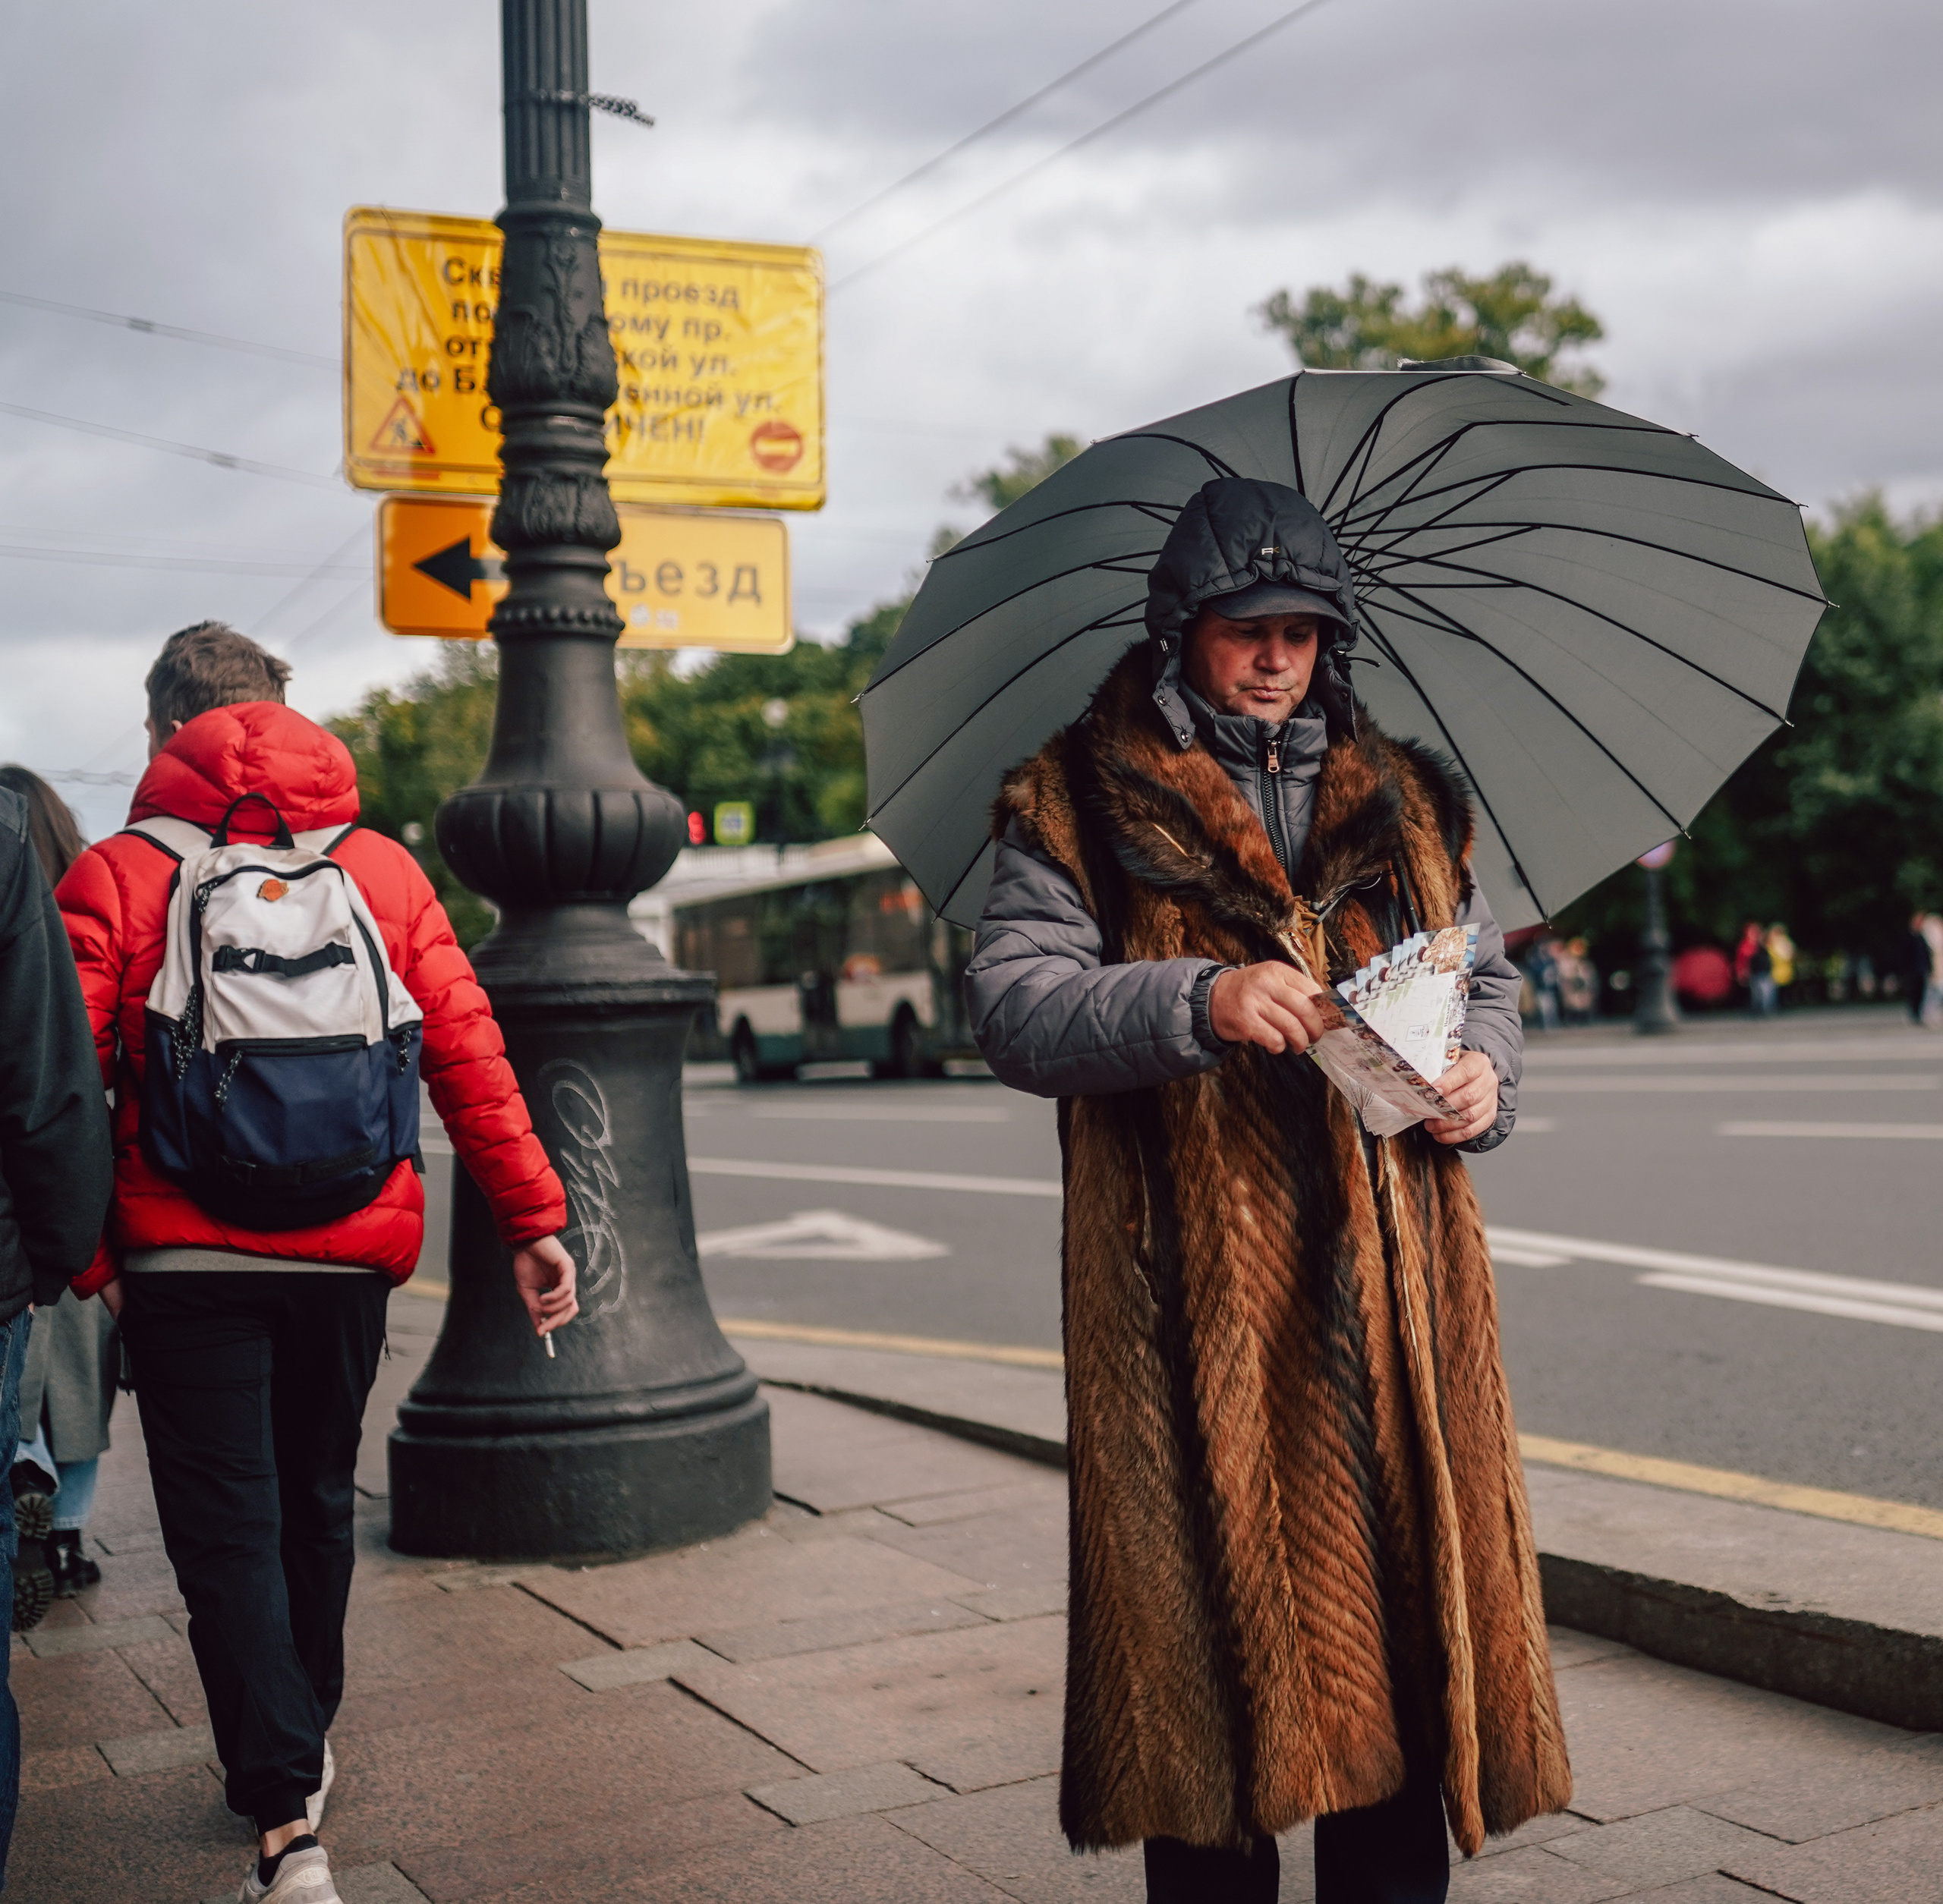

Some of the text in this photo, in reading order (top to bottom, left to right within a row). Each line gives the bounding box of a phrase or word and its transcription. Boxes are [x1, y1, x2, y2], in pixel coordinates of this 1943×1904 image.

[621, 279, 741, 310] проезд
[453, 300, 492, 323] по
[683, 317, 732, 345] пр.
[446, 335, 483, 357] от
[690, 352, 737, 376] ул.
[397, 367, 440, 392] до
[735, 389, 783, 418] ул.
[612, 559, 762, 605] ъезд
